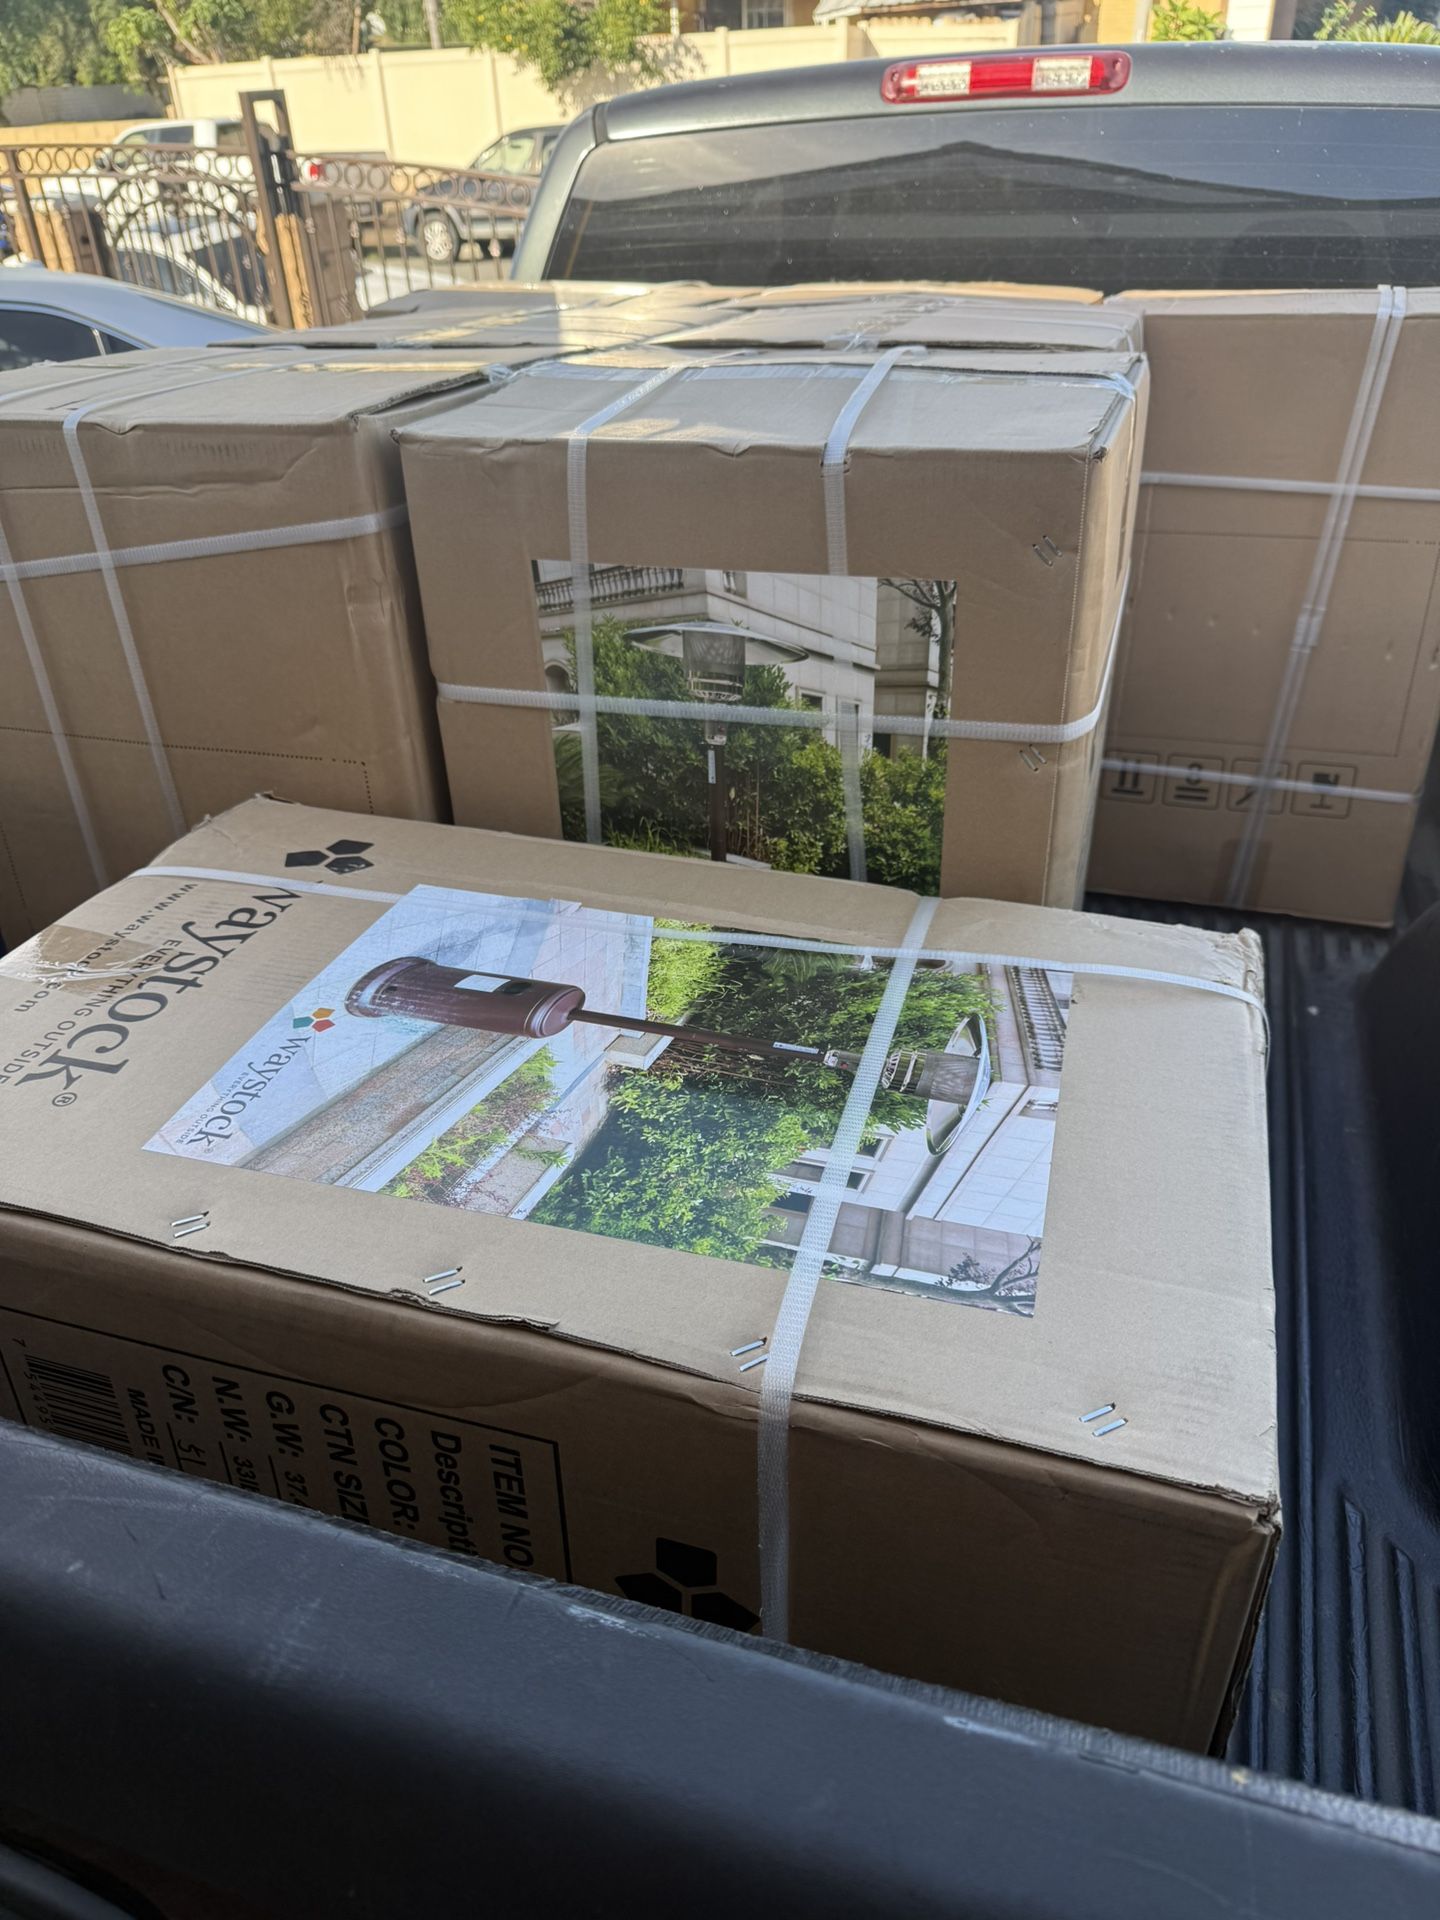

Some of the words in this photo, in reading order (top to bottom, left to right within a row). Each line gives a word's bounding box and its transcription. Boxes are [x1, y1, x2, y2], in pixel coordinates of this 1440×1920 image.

[15, 882, 198, 1013] www.waystoccom
[206, 1071, 249, 1113] EVERYTHING
[175, 1113, 208, 1145] OUTSIDE
[127, 1387, 162, 1449] MADE
[162, 1364, 200, 1424] C/N:
[211, 1376, 253, 1443] N.W:
[265, 1390, 305, 1458] G.W:
[319, 1403, 358, 1466] CTN
[374, 1417, 420, 1530] COLOR:
[488, 1443, 530, 1520] ITEM
